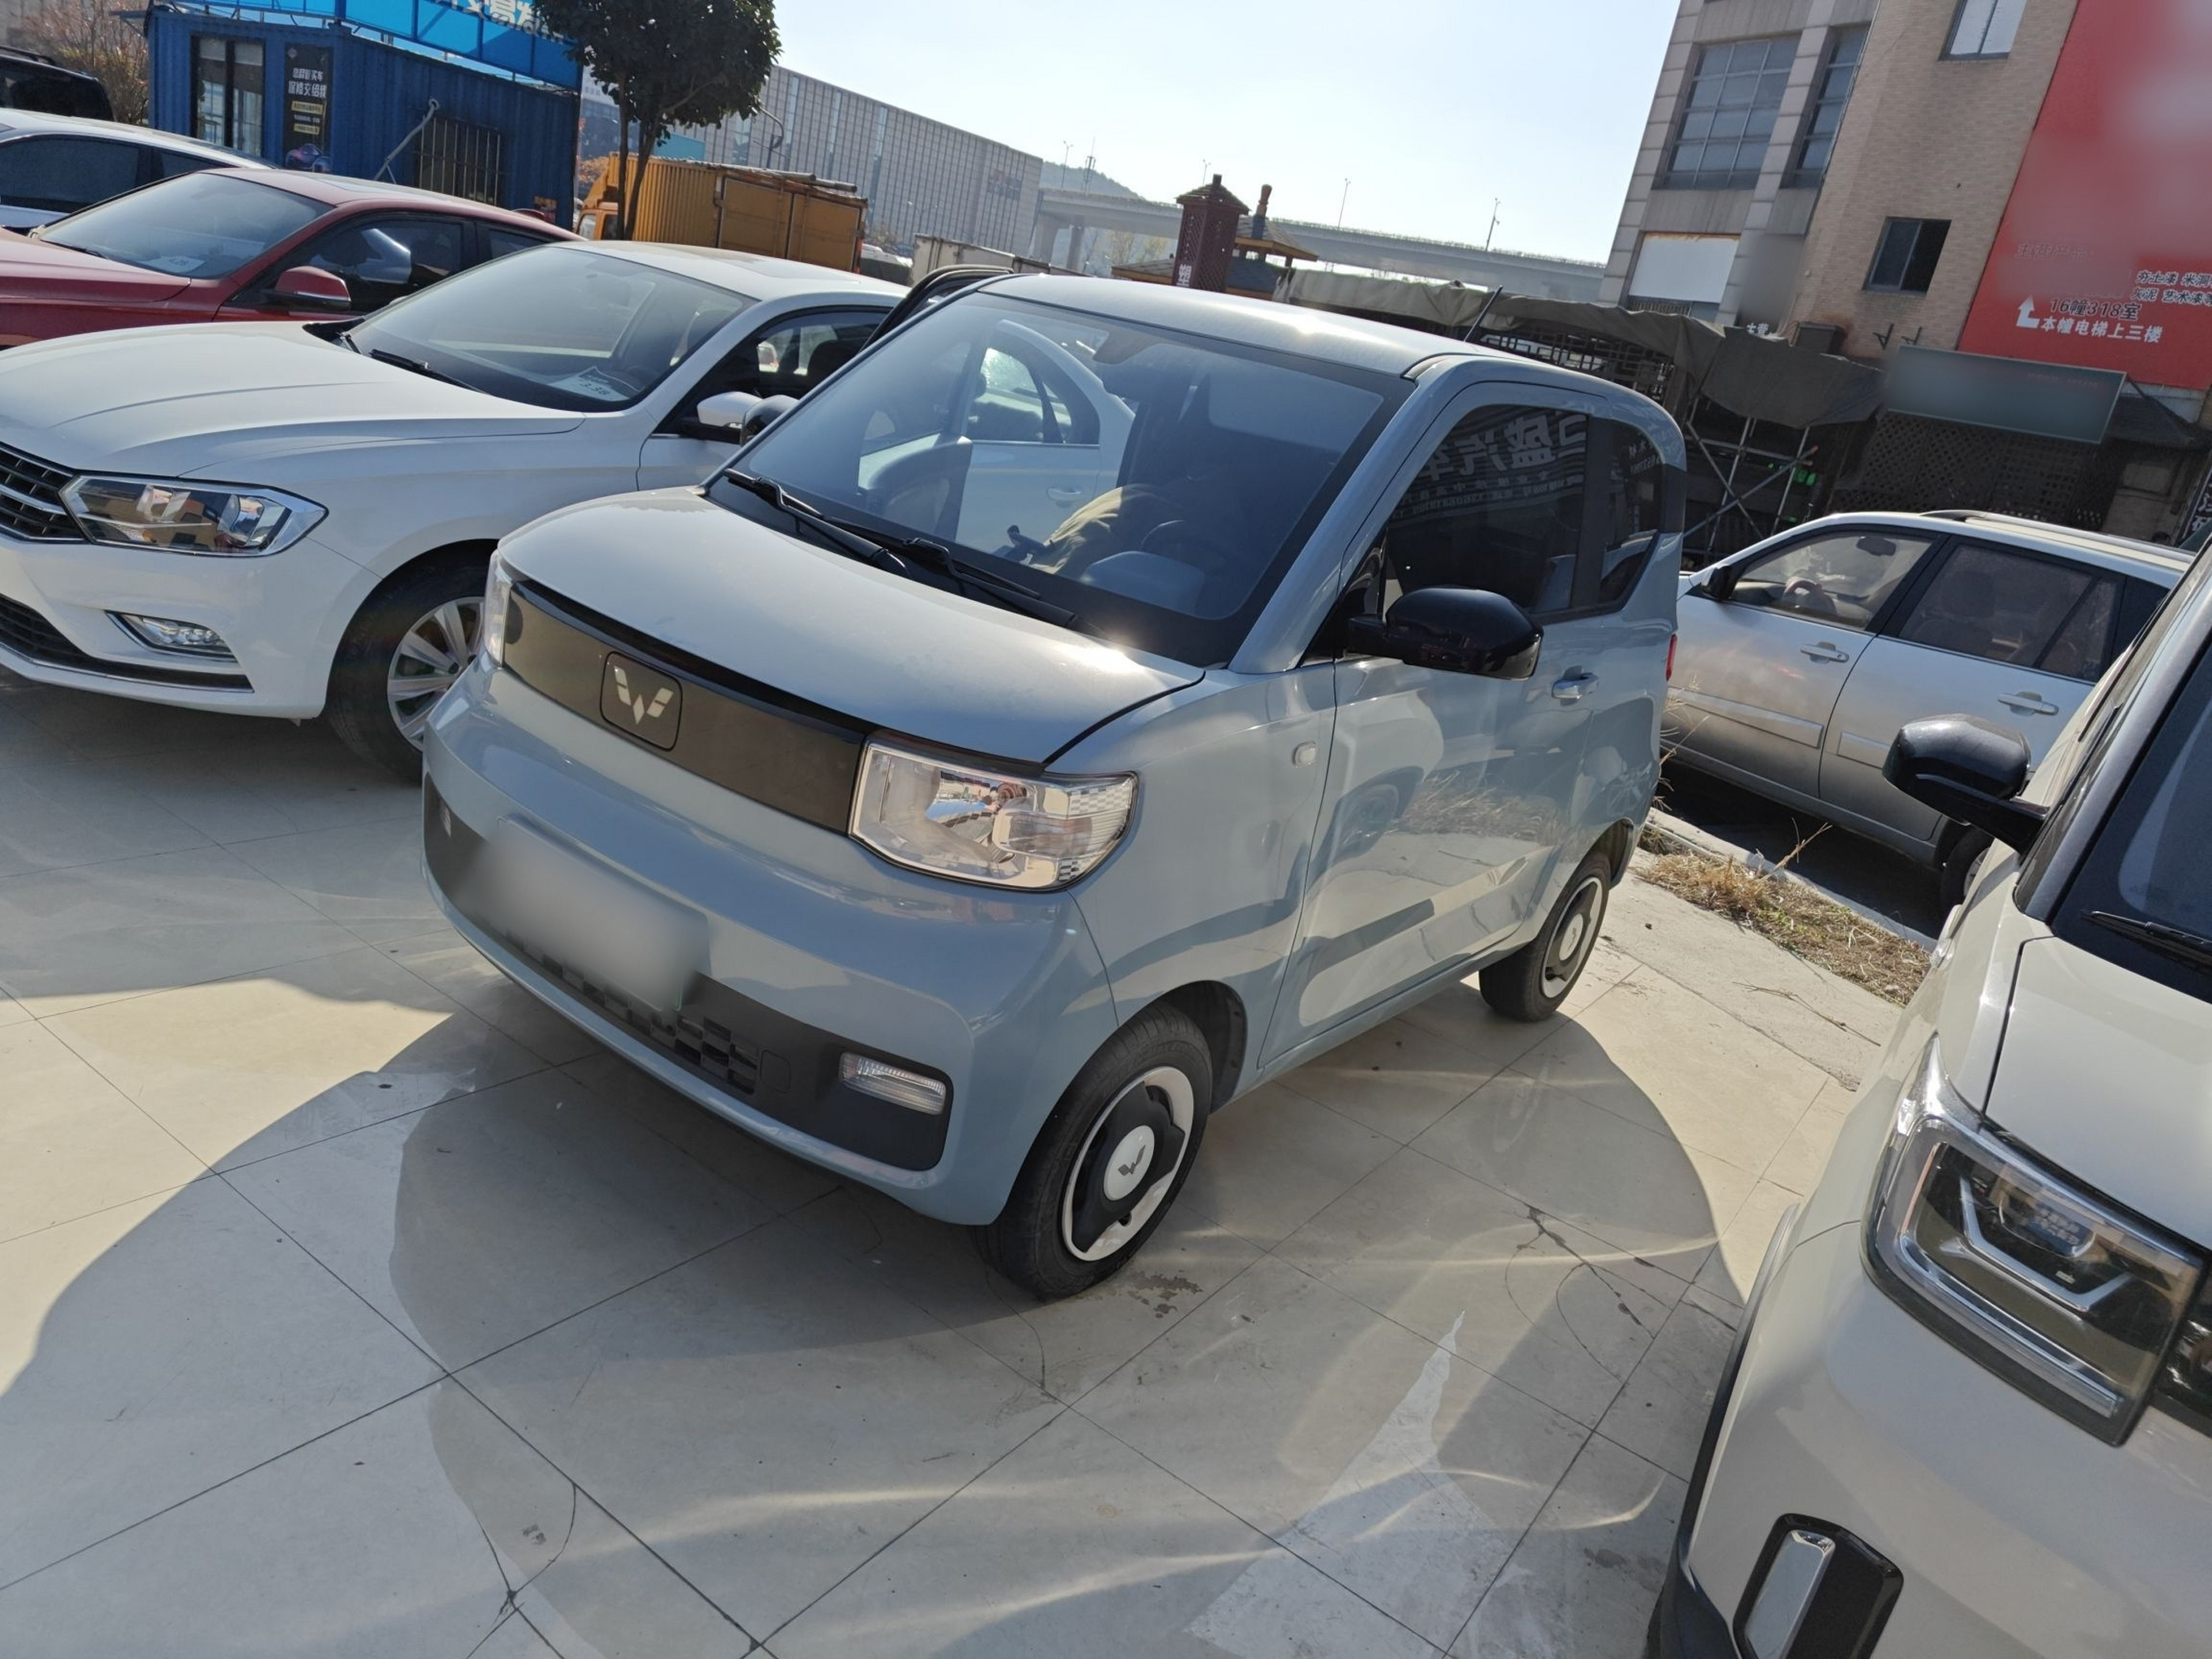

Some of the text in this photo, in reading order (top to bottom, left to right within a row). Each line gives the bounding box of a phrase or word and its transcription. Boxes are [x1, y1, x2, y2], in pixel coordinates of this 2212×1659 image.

[2180, 271, 2212, 288] 米洞
[2050, 297, 2142, 321] 16幢318室
[2041, 316, 2163, 343] 本幢电梯上三楼
